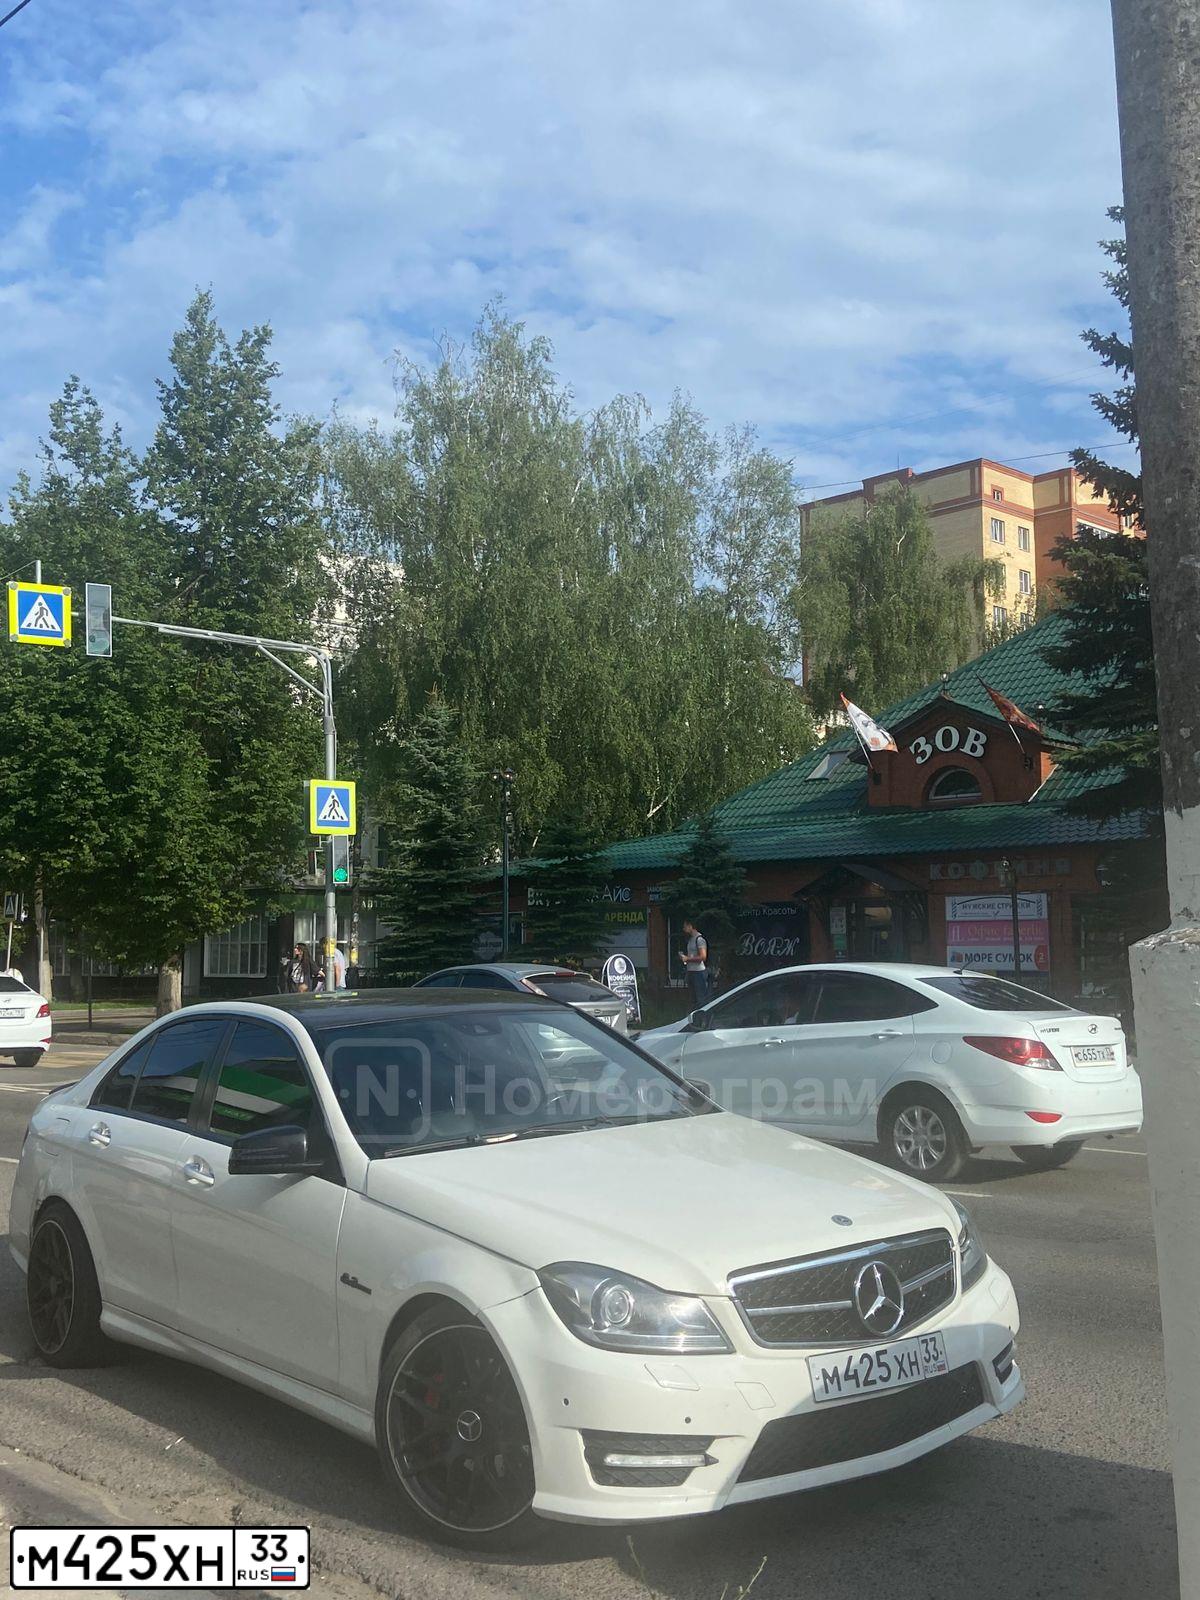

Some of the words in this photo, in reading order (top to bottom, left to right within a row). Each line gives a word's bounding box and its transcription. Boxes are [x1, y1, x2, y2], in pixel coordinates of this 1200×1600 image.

[909, 725, 988, 765] ЗОВ
[605, 911, 644, 923] АРЕНДА
[964, 952, 993, 963] МОРЕ
[821, 1349, 921, 1394] М425ХН
[921, 1337, 940, 1363] 33
